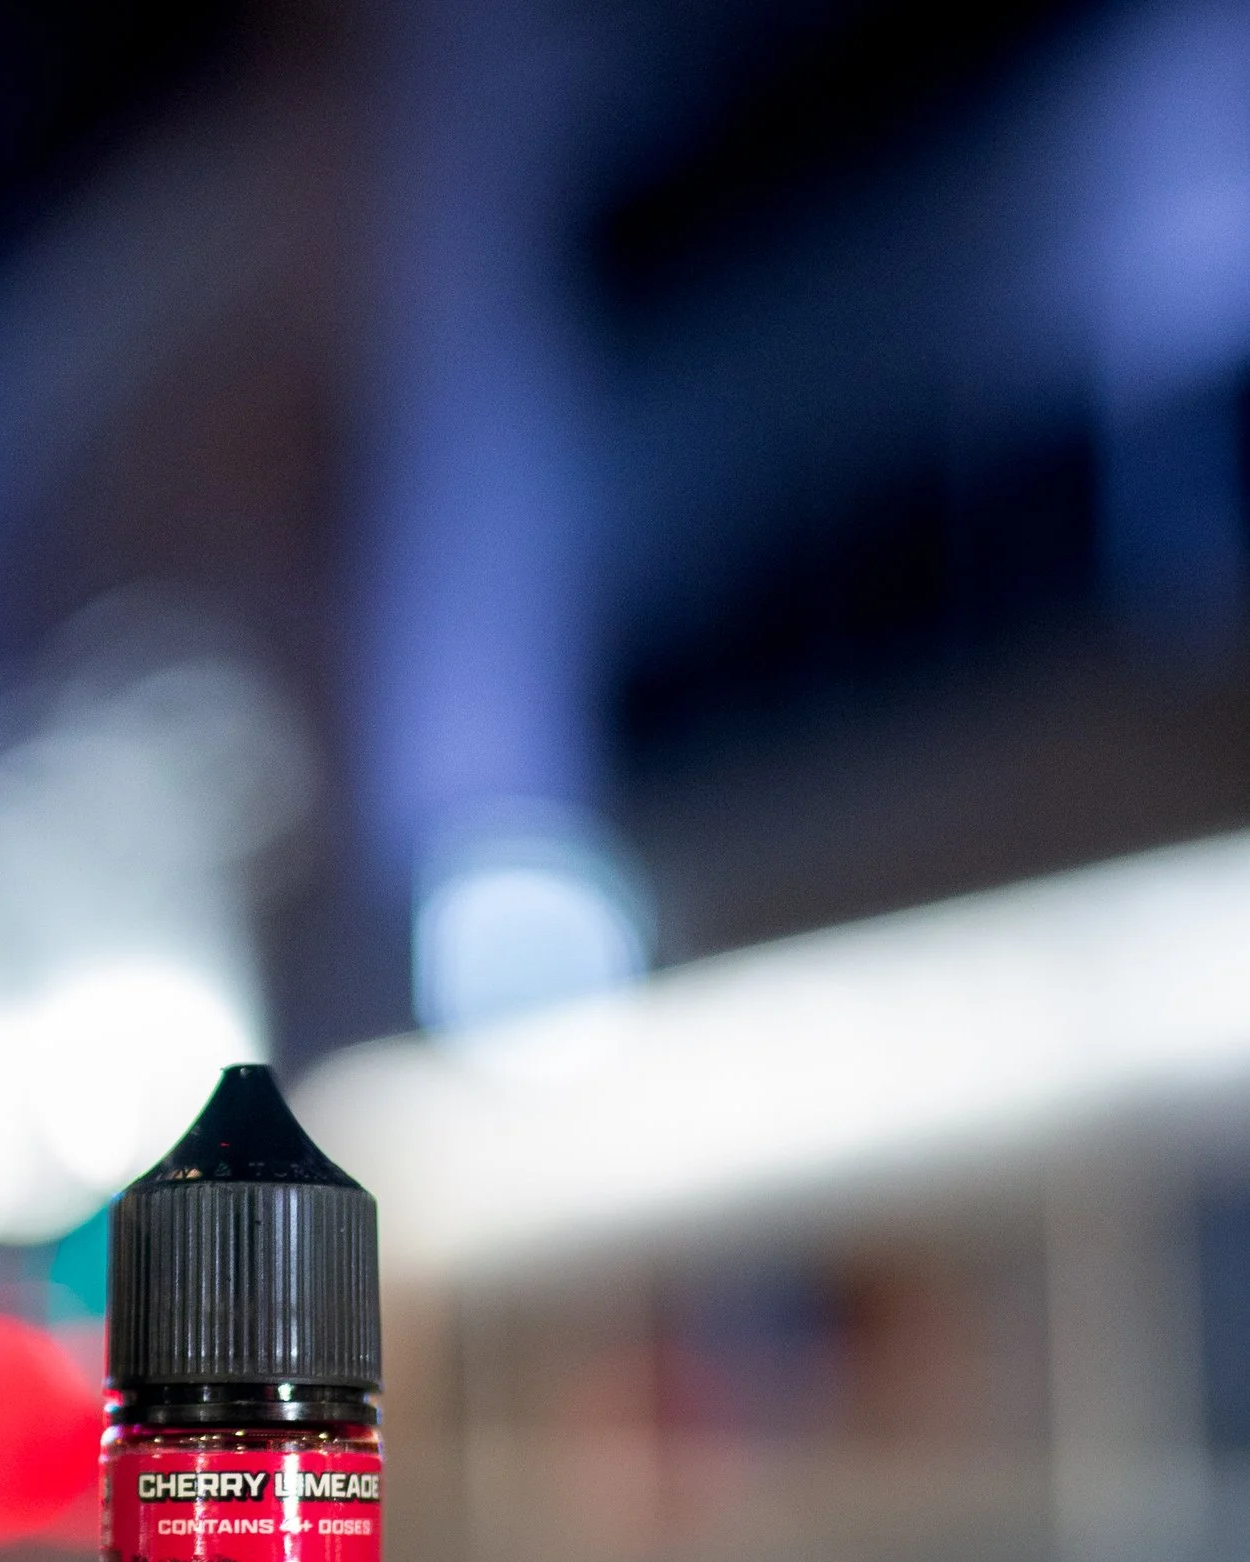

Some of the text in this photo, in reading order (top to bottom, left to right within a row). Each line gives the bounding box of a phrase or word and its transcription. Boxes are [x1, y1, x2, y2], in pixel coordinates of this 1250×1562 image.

[138, 1470, 270, 1503] CHERRY
[158, 1518, 274, 1535] CONTAINS
[317, 1518, 373, 1536] DOSES
